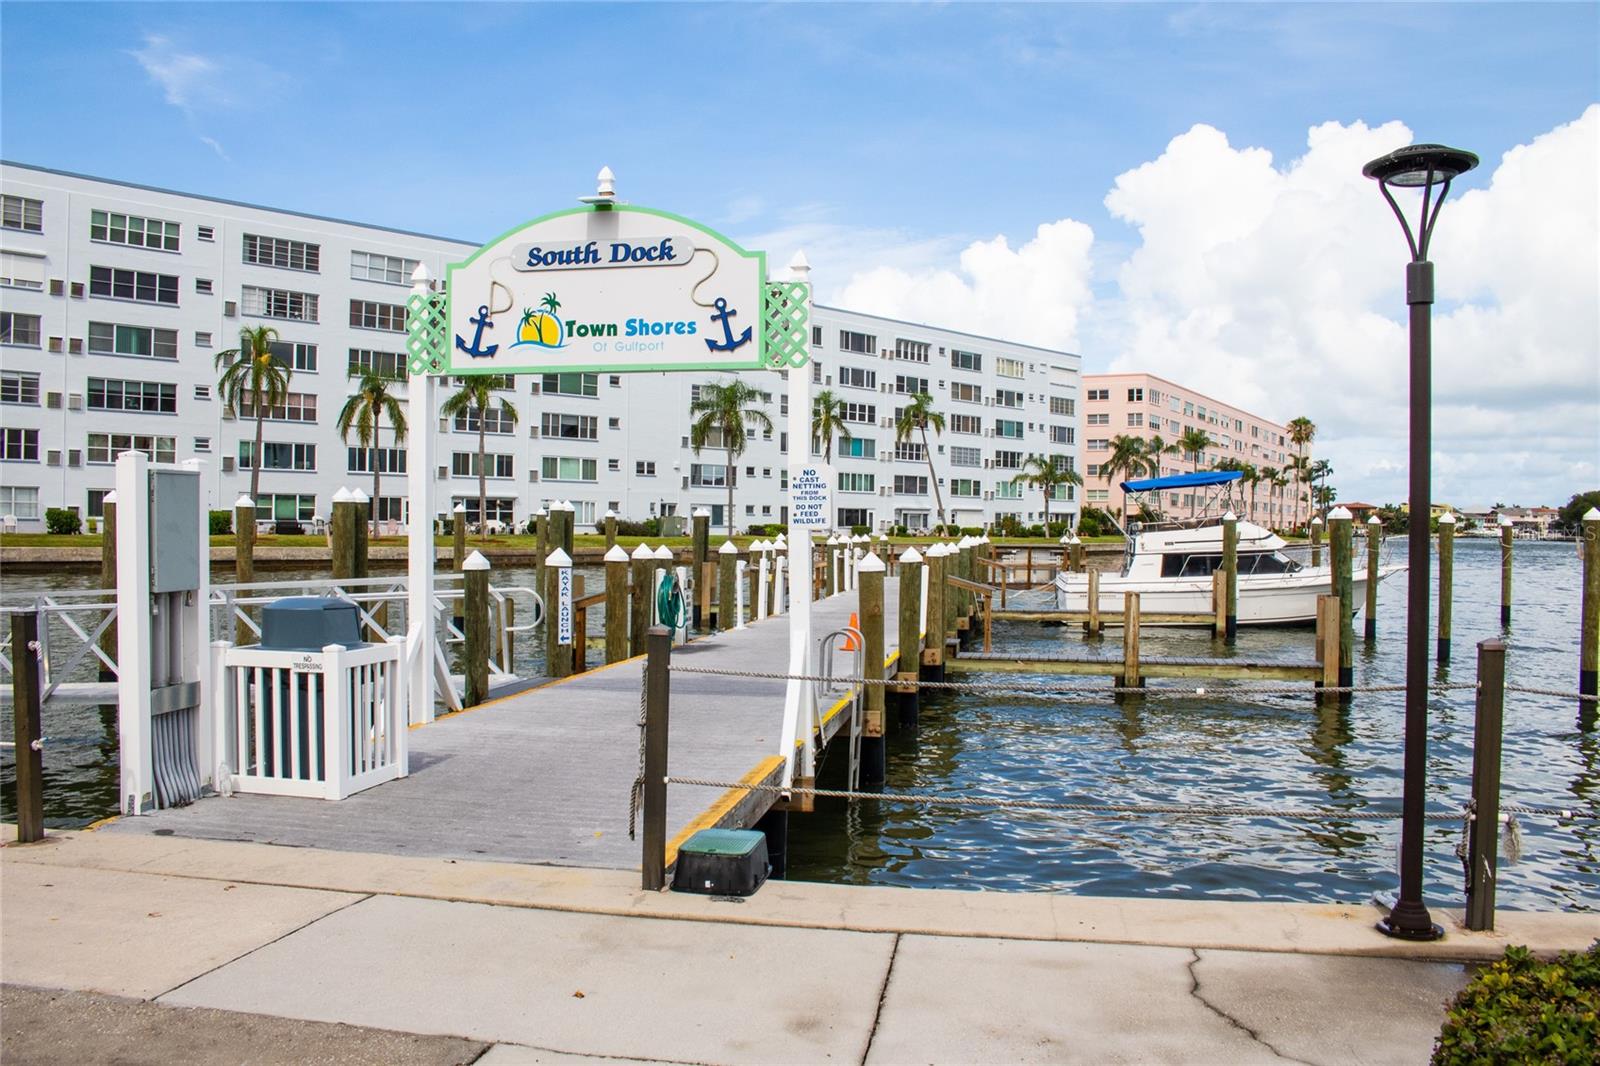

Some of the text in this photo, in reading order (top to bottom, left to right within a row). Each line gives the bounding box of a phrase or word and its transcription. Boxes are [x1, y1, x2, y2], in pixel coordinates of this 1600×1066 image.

[527, 238, 677, 267] South Dock
[565, 318, 697, 338] Town Shores
[592, 341, 664, 352] Of Gulfport
[561, 570, 569, 597] KAYAK
[561, 601, 569, 633] LAUNCH
